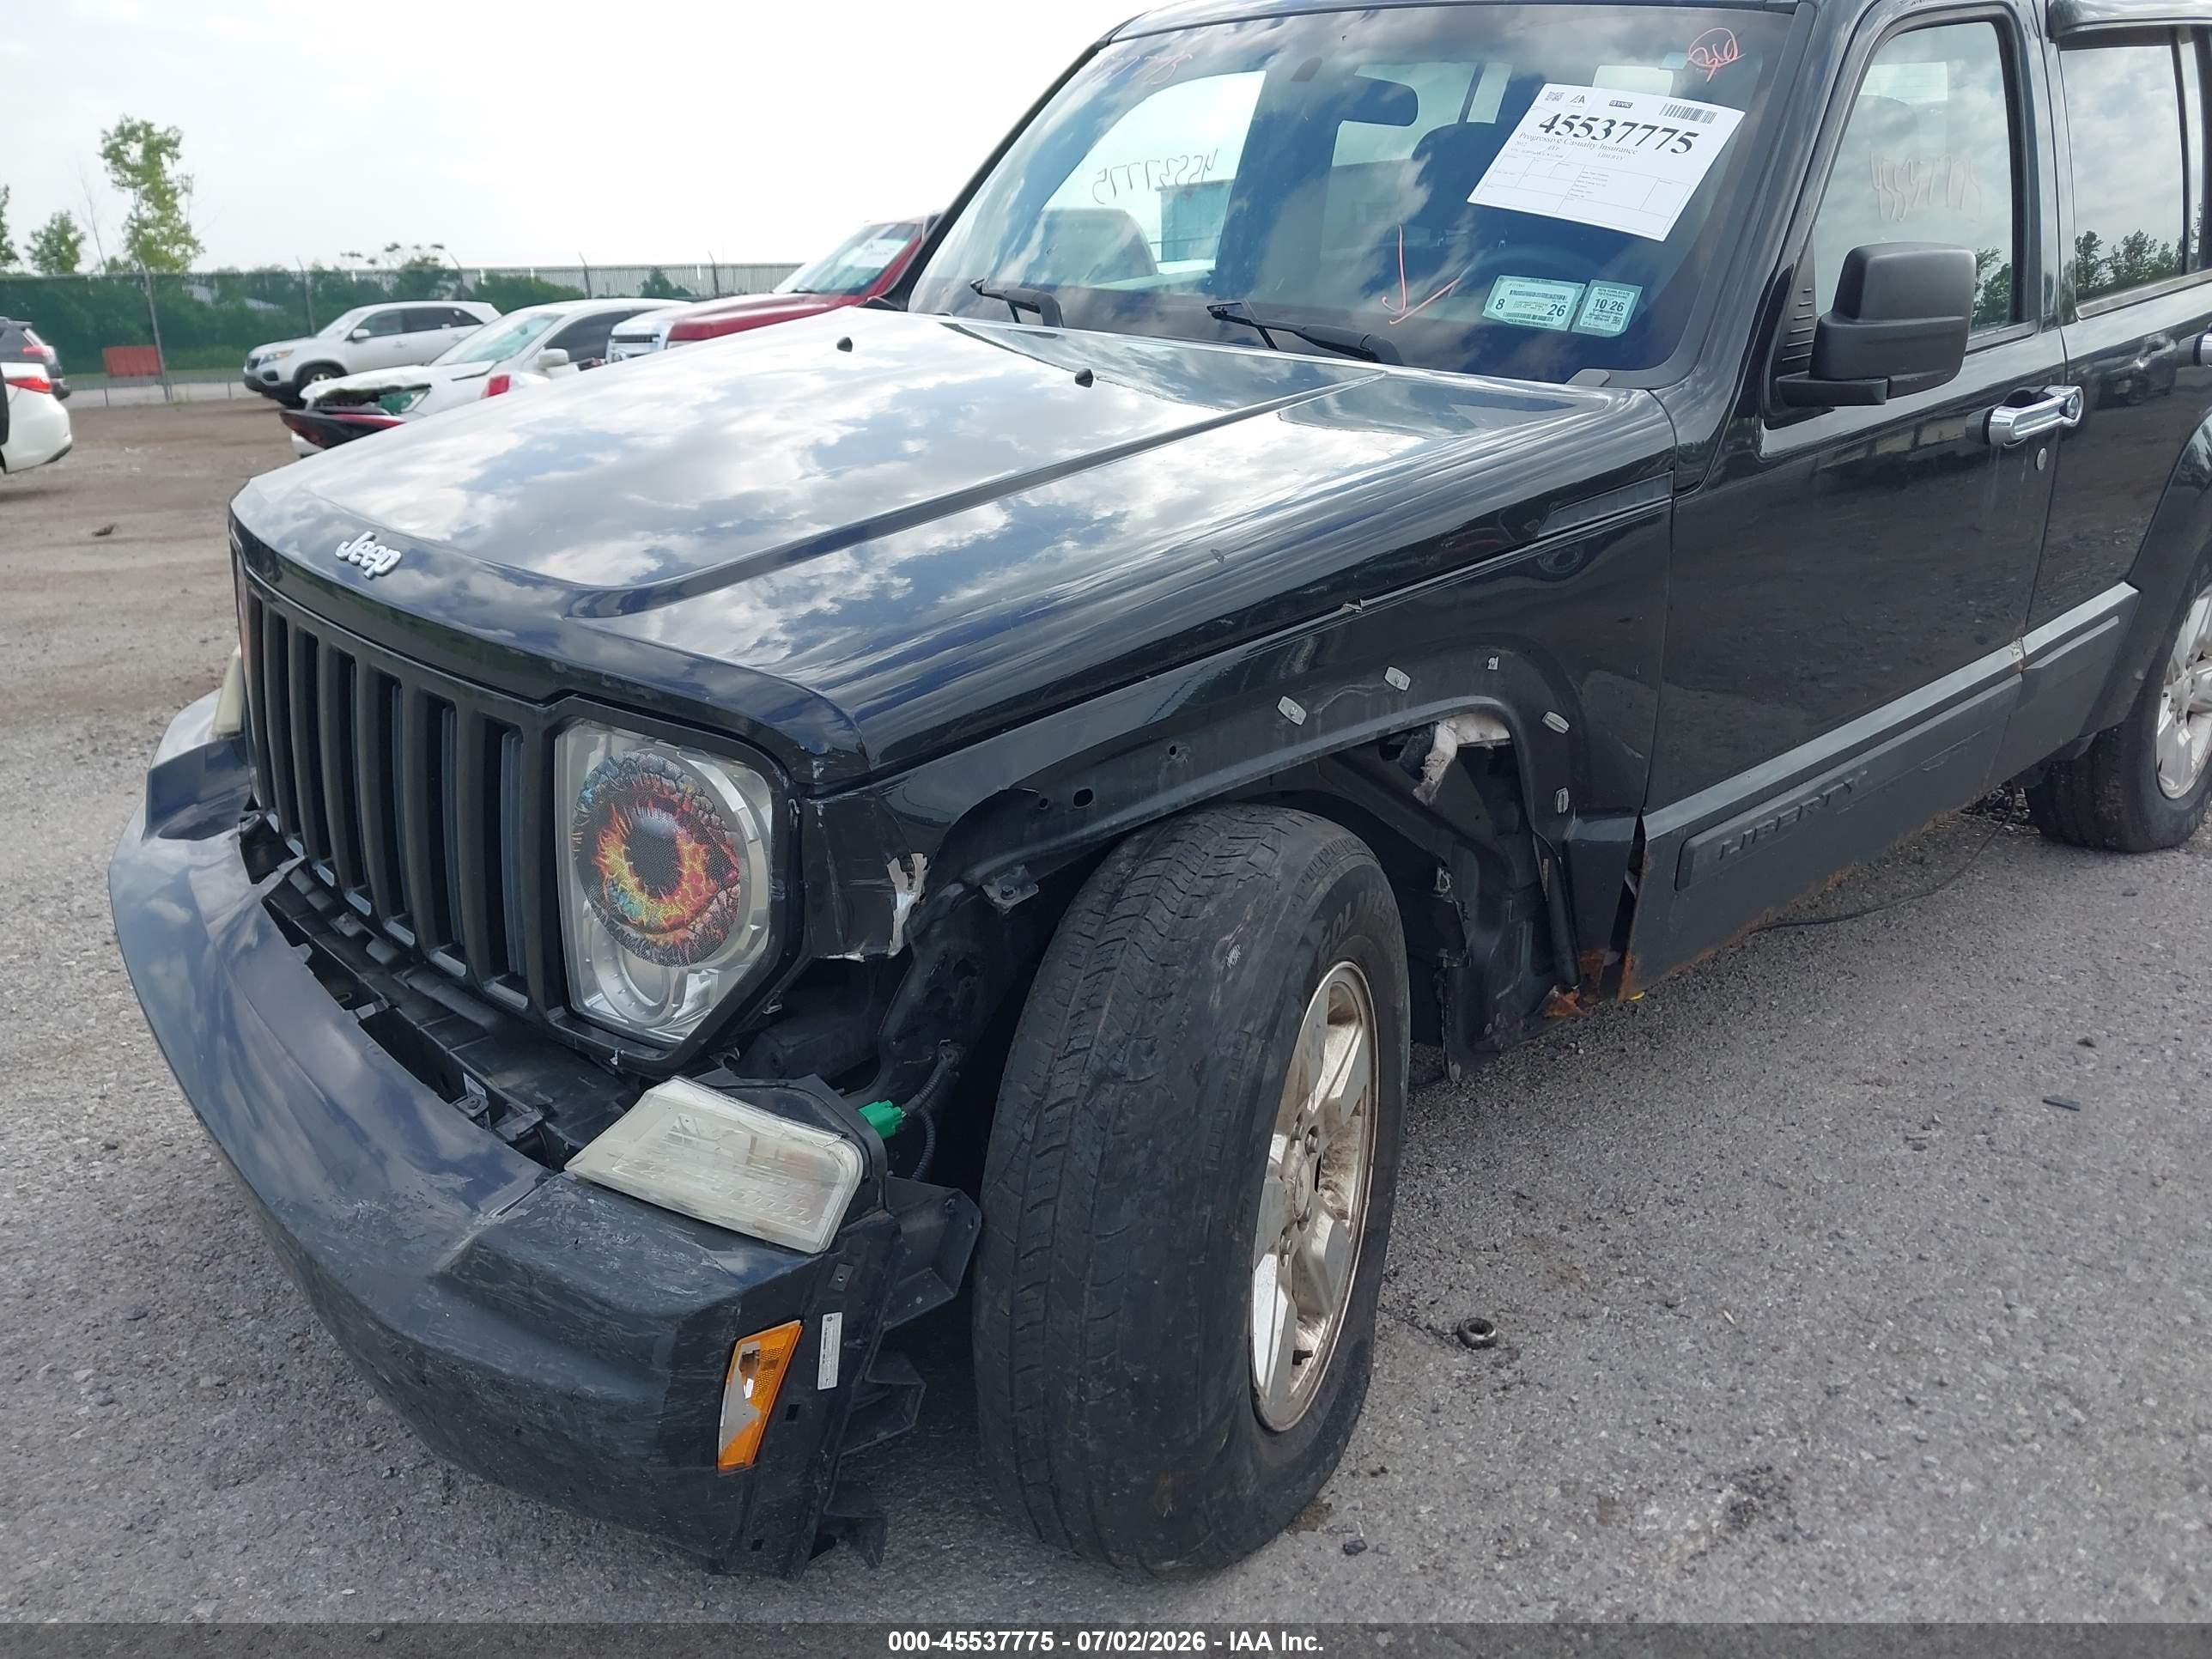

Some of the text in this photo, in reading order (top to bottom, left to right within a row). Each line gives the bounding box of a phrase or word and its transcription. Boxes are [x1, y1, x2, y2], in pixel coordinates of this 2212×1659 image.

[1539, 112, 1701, 155] 45537775
[1564, 137, 1597, 152] Casualty
[1599, 143, 1638, 155] Insurance
[1495, 298, 1505, 310] 8
[1547, 303, 1567, 317] 26
[1595, 298, 1608, 309] 10
[1609, 301, 1626, 313] 26
[335, 531, 402, 580] Jeep
